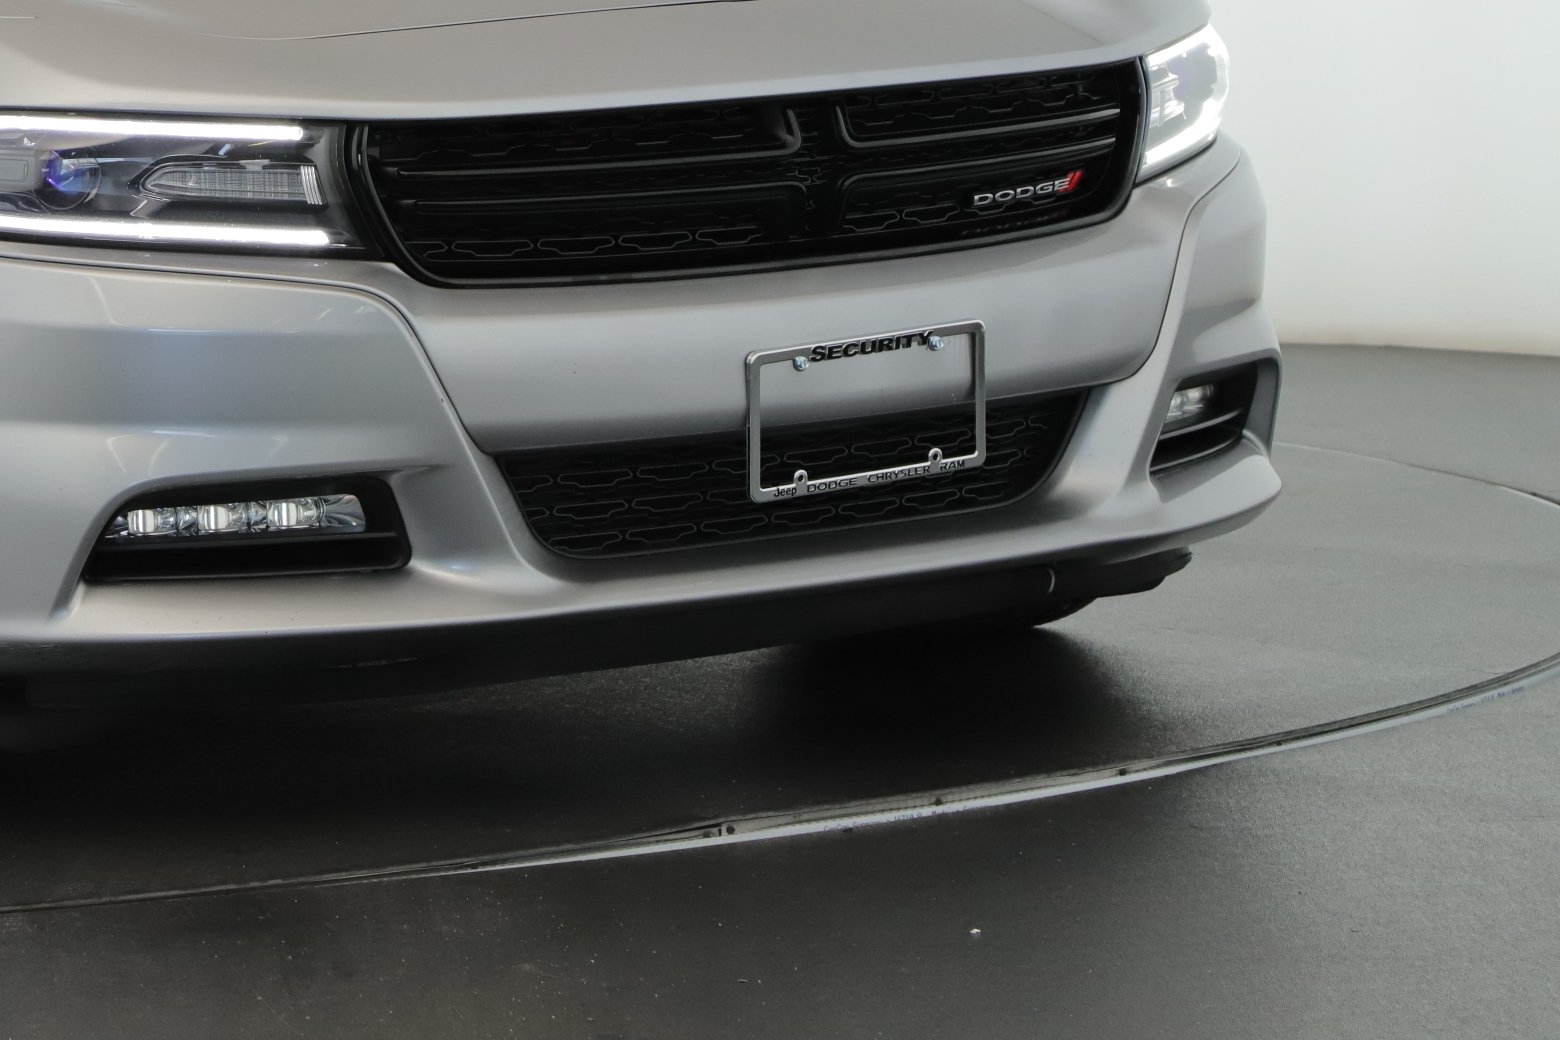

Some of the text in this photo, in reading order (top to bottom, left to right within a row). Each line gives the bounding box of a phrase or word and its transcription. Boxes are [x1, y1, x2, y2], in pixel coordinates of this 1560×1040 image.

[973, 177, 1071, 206] DODGE
[809, 330, 934, 364] SECURITY
[773, 459, 966, 498] Jeep DODGE CHRYSLER RAM
